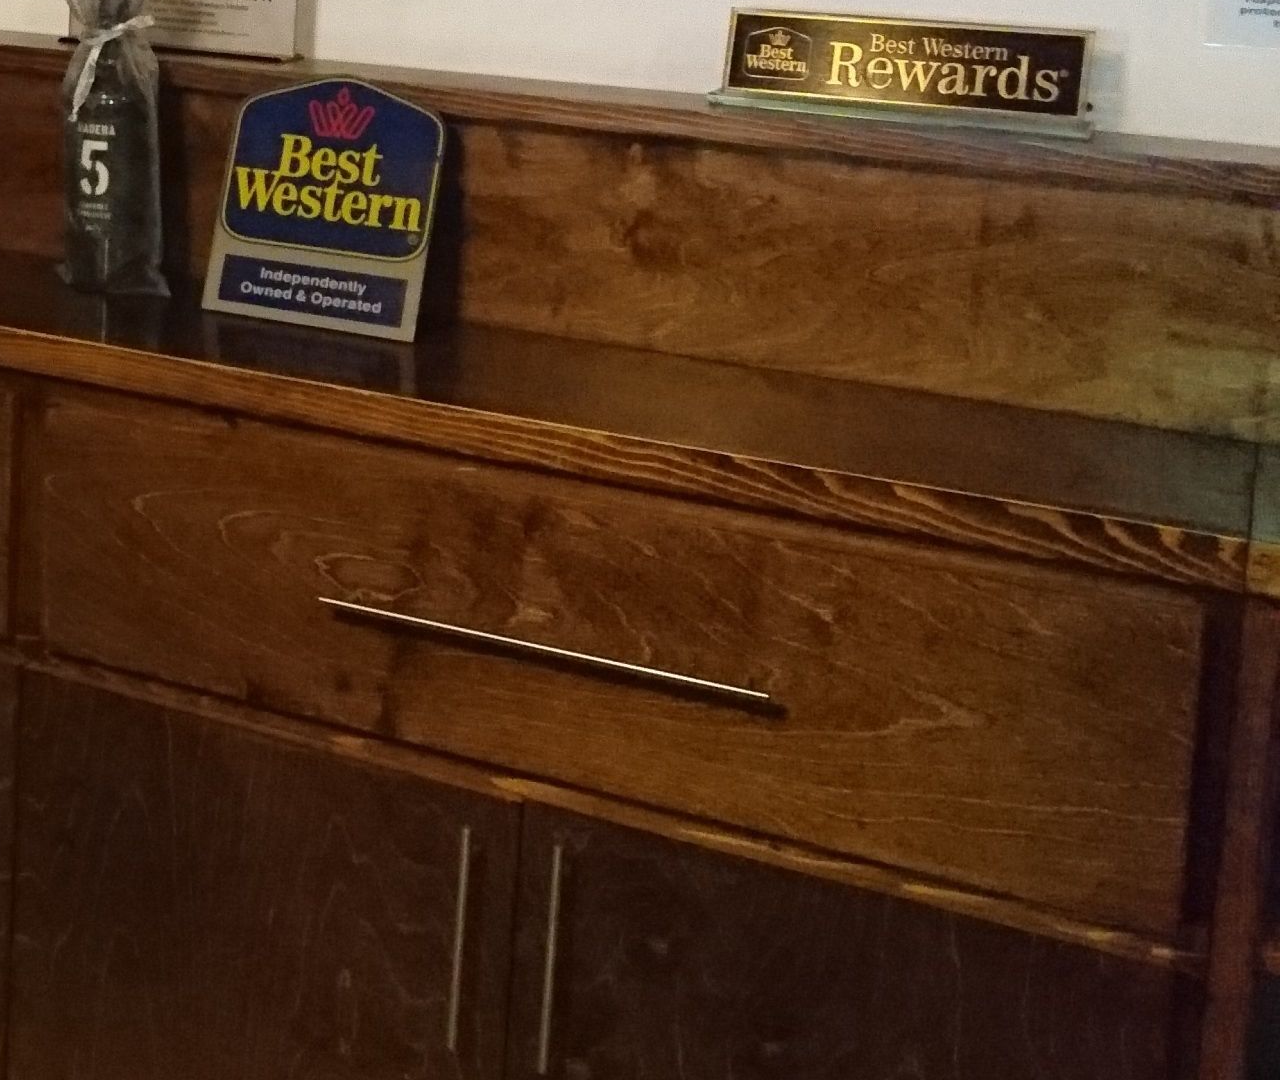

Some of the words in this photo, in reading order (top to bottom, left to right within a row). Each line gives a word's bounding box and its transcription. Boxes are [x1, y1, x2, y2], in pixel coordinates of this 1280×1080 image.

[745, 53, 807, 73] Western
[759, 43, 794, 60] Best
[869, 33, 916, 56] Best
[922, 36, 1009, 62] Western
[825, 40, 1060, 103] Rewards
[79, 139, 110, 196] 5
[278, 133, 384, 187] Best
[234, 166, 422, 232] Western
[240, 281, 293, 301] Owned
[295, 289, 307, 302] &
[310, 291, 383, 315] Operated
[260, 266, 367, 296] Independently
